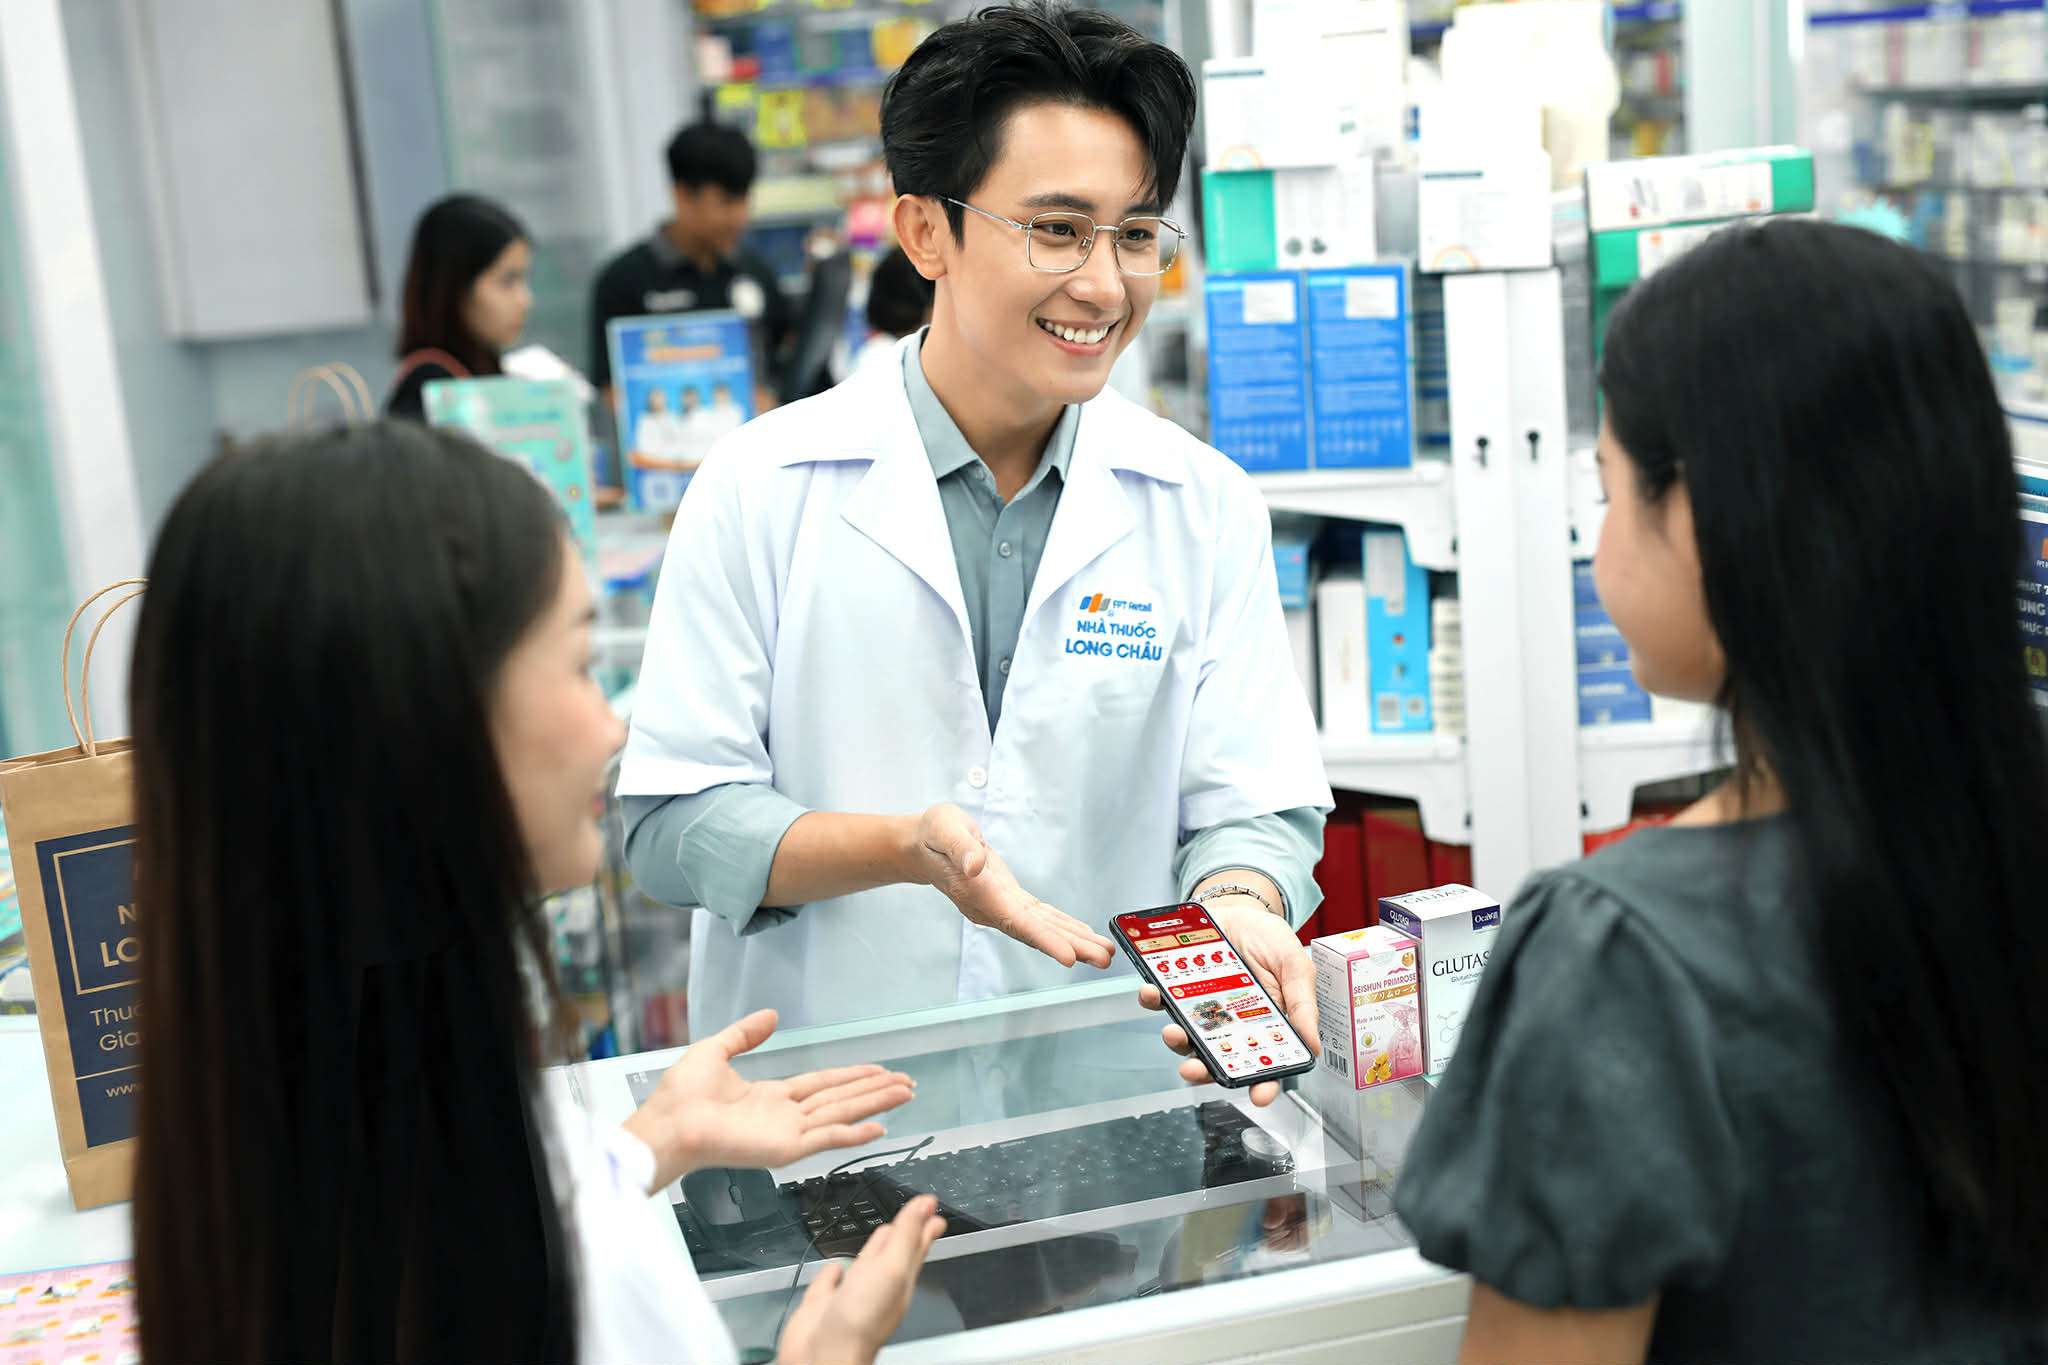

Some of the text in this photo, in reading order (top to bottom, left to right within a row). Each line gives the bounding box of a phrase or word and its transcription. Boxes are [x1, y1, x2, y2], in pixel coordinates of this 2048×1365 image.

[1077, 617, 1156, 639] NHÀ THUỐC
[1065, 638, 1162, 661] LONG CHÂU
[1432, 950, 1490, 977] GLUTAS
[1353, 972, 1416, 995] SEISHUN PRIMROSE
